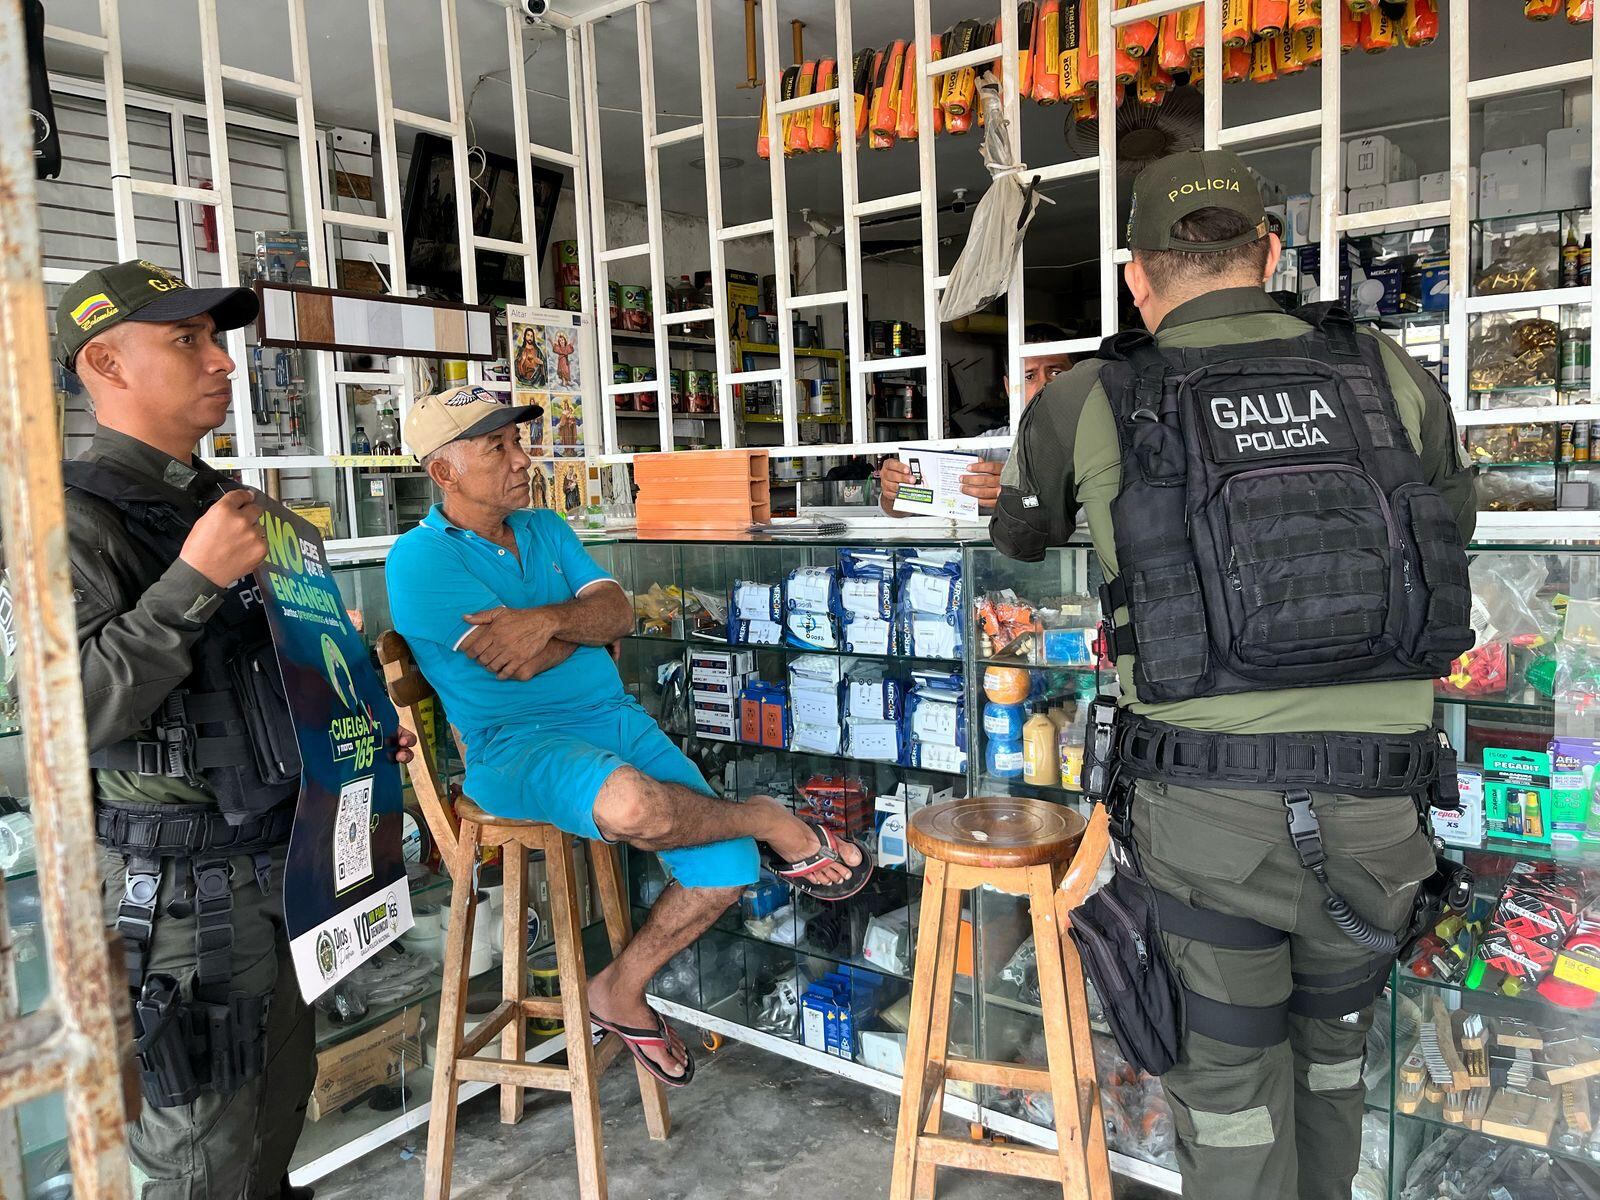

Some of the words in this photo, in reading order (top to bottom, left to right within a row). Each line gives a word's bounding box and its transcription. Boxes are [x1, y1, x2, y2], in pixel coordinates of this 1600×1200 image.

[1063, 56, 1071, 89] VIGOR
[1168, 179, 1240, 202] POLICIA
[1210, 389, 1337, 429] GAULA
[1235, 423, 1330, 453] POLICÍA
[887, 682, 895, 720] MERCURY
[331, 715, 370, 740] CUELGA
[354, 736, 375, 771] 165
[1555, 755, 1580, 764] Afix
[333, 927, 348, 949] Dios
[353, 912, 371, 949] YO
